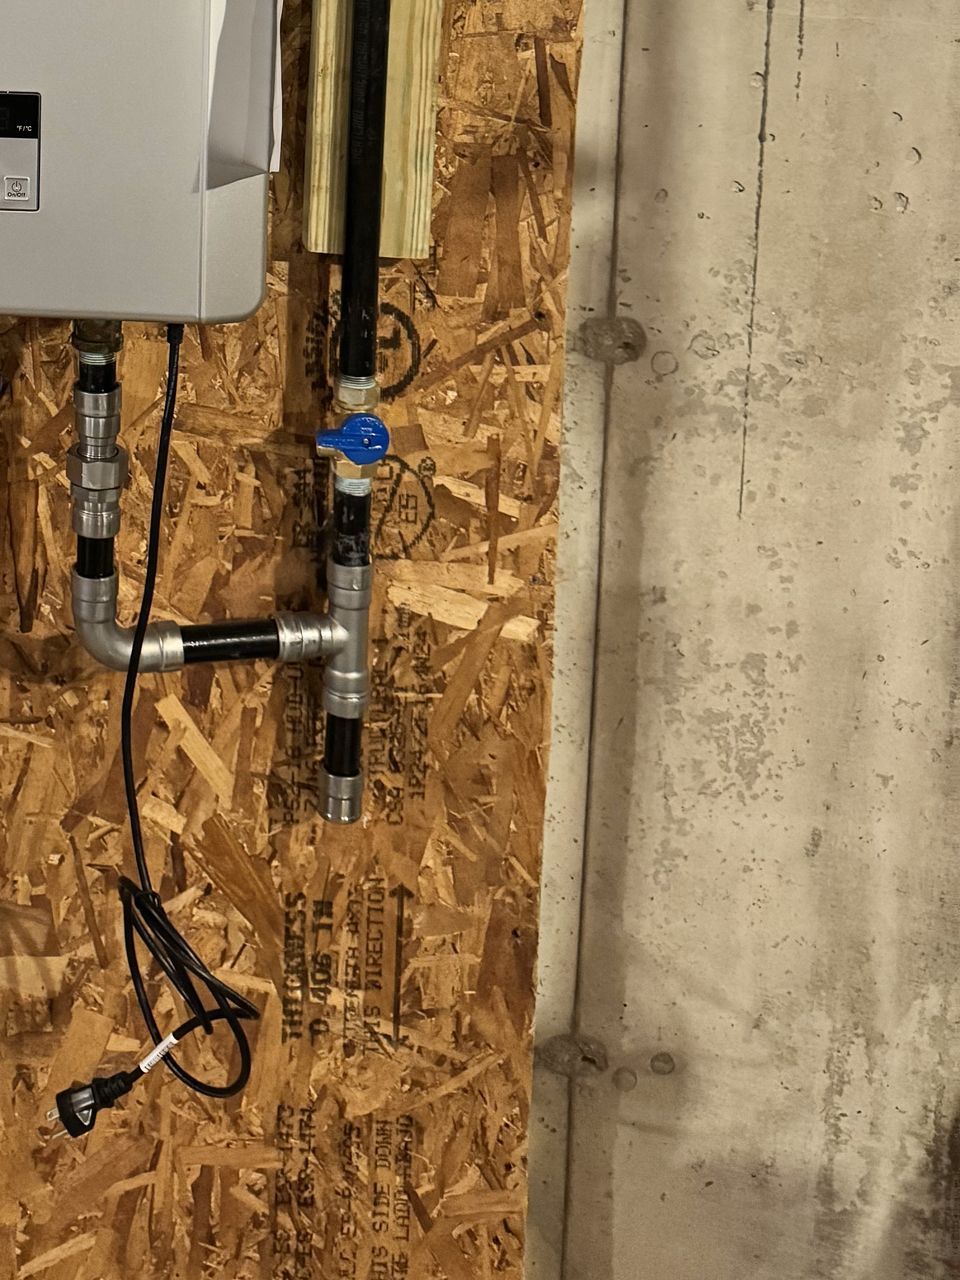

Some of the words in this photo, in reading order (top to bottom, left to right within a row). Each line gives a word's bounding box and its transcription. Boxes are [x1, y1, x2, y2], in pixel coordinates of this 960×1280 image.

[281, 891, 307, 1045] THICKNESS
[364, 877, 385, 990] DIRECTION
[374, 1118, 393, 1171] DOWN
[371, 1181, 391, 1234] SIDE
